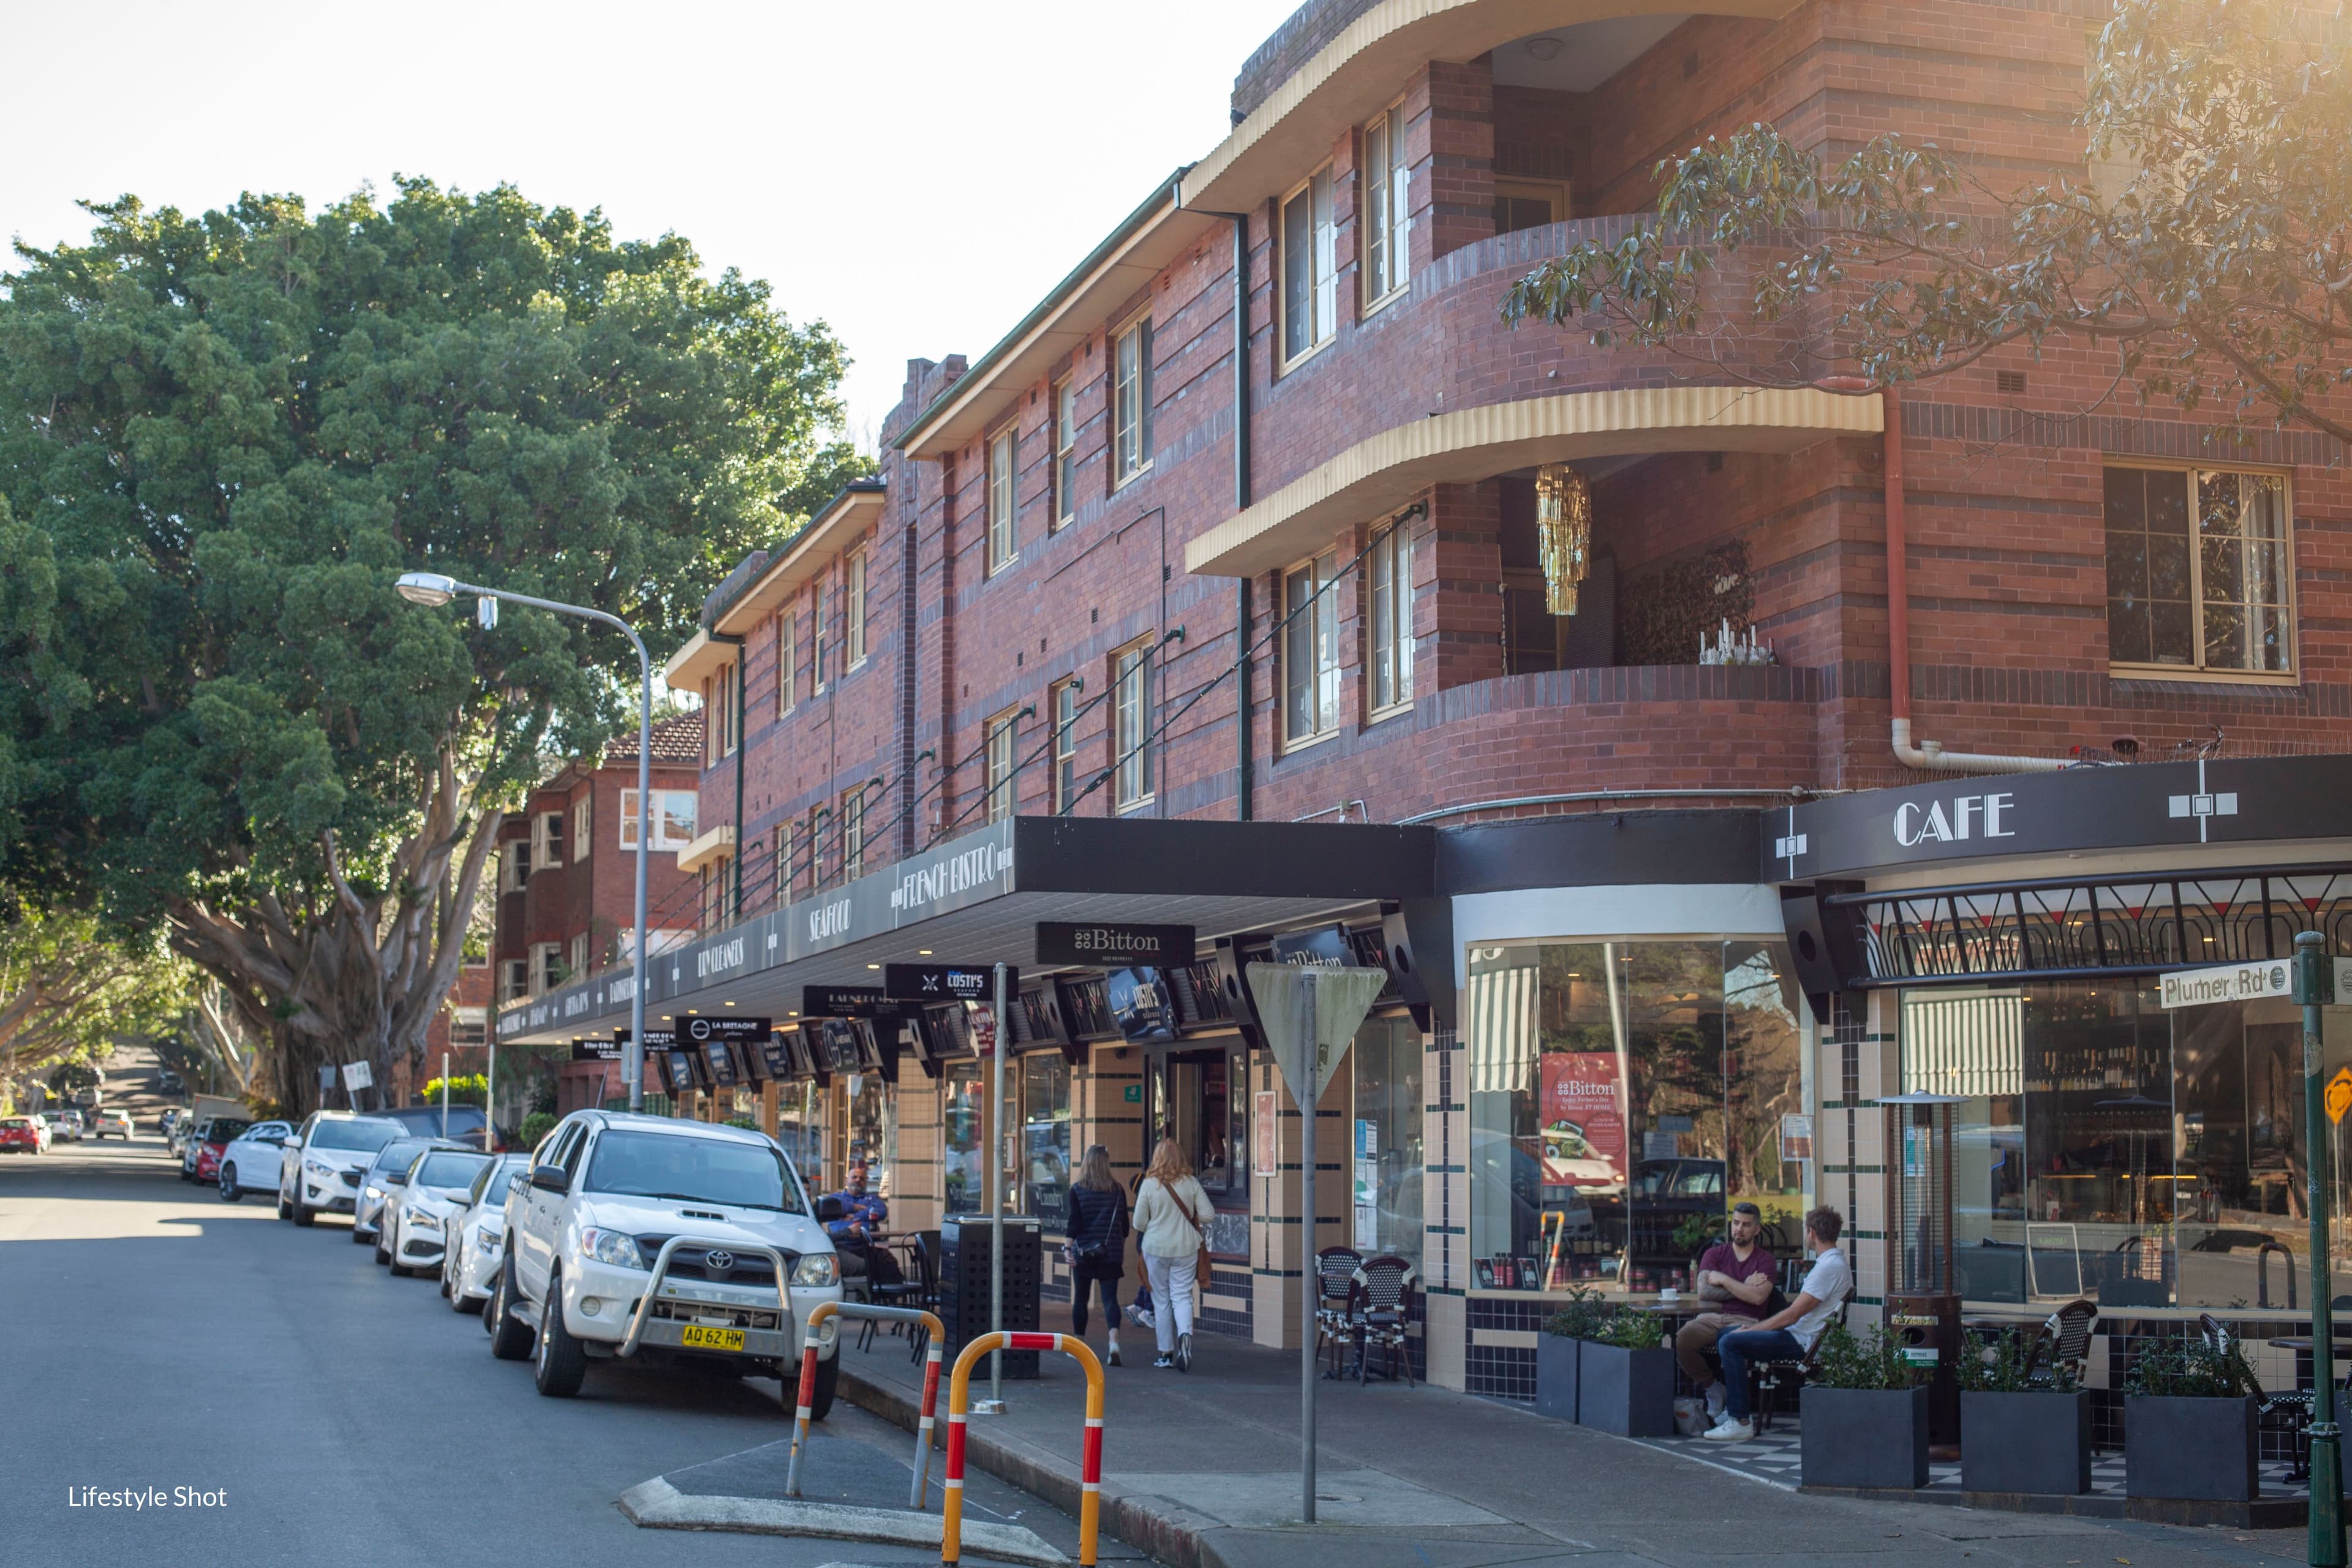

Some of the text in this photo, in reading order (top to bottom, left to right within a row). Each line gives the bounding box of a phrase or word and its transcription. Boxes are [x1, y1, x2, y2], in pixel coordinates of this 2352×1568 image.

[1893, 792, 2016, 847] CAFE
[903, 842, 997, 910] FRENCH BISTRO
[809, 899, 852, 943] SEAFOOD
[710, 936, 744, 974] CLEANERS
[1091, 929, 1161, 951] Bitton
[947, 974, 983, 988] COSTI'S
[1133, 982, 1159, 1010] COSTI'S
[2165, 977, 2230, 1003] Plumer
[2238, 967, 2263, 994] Rd
[722, 1021, 758, 1030] BRETAGNE
[1569, 1080, 1615, 1096] Bitton
